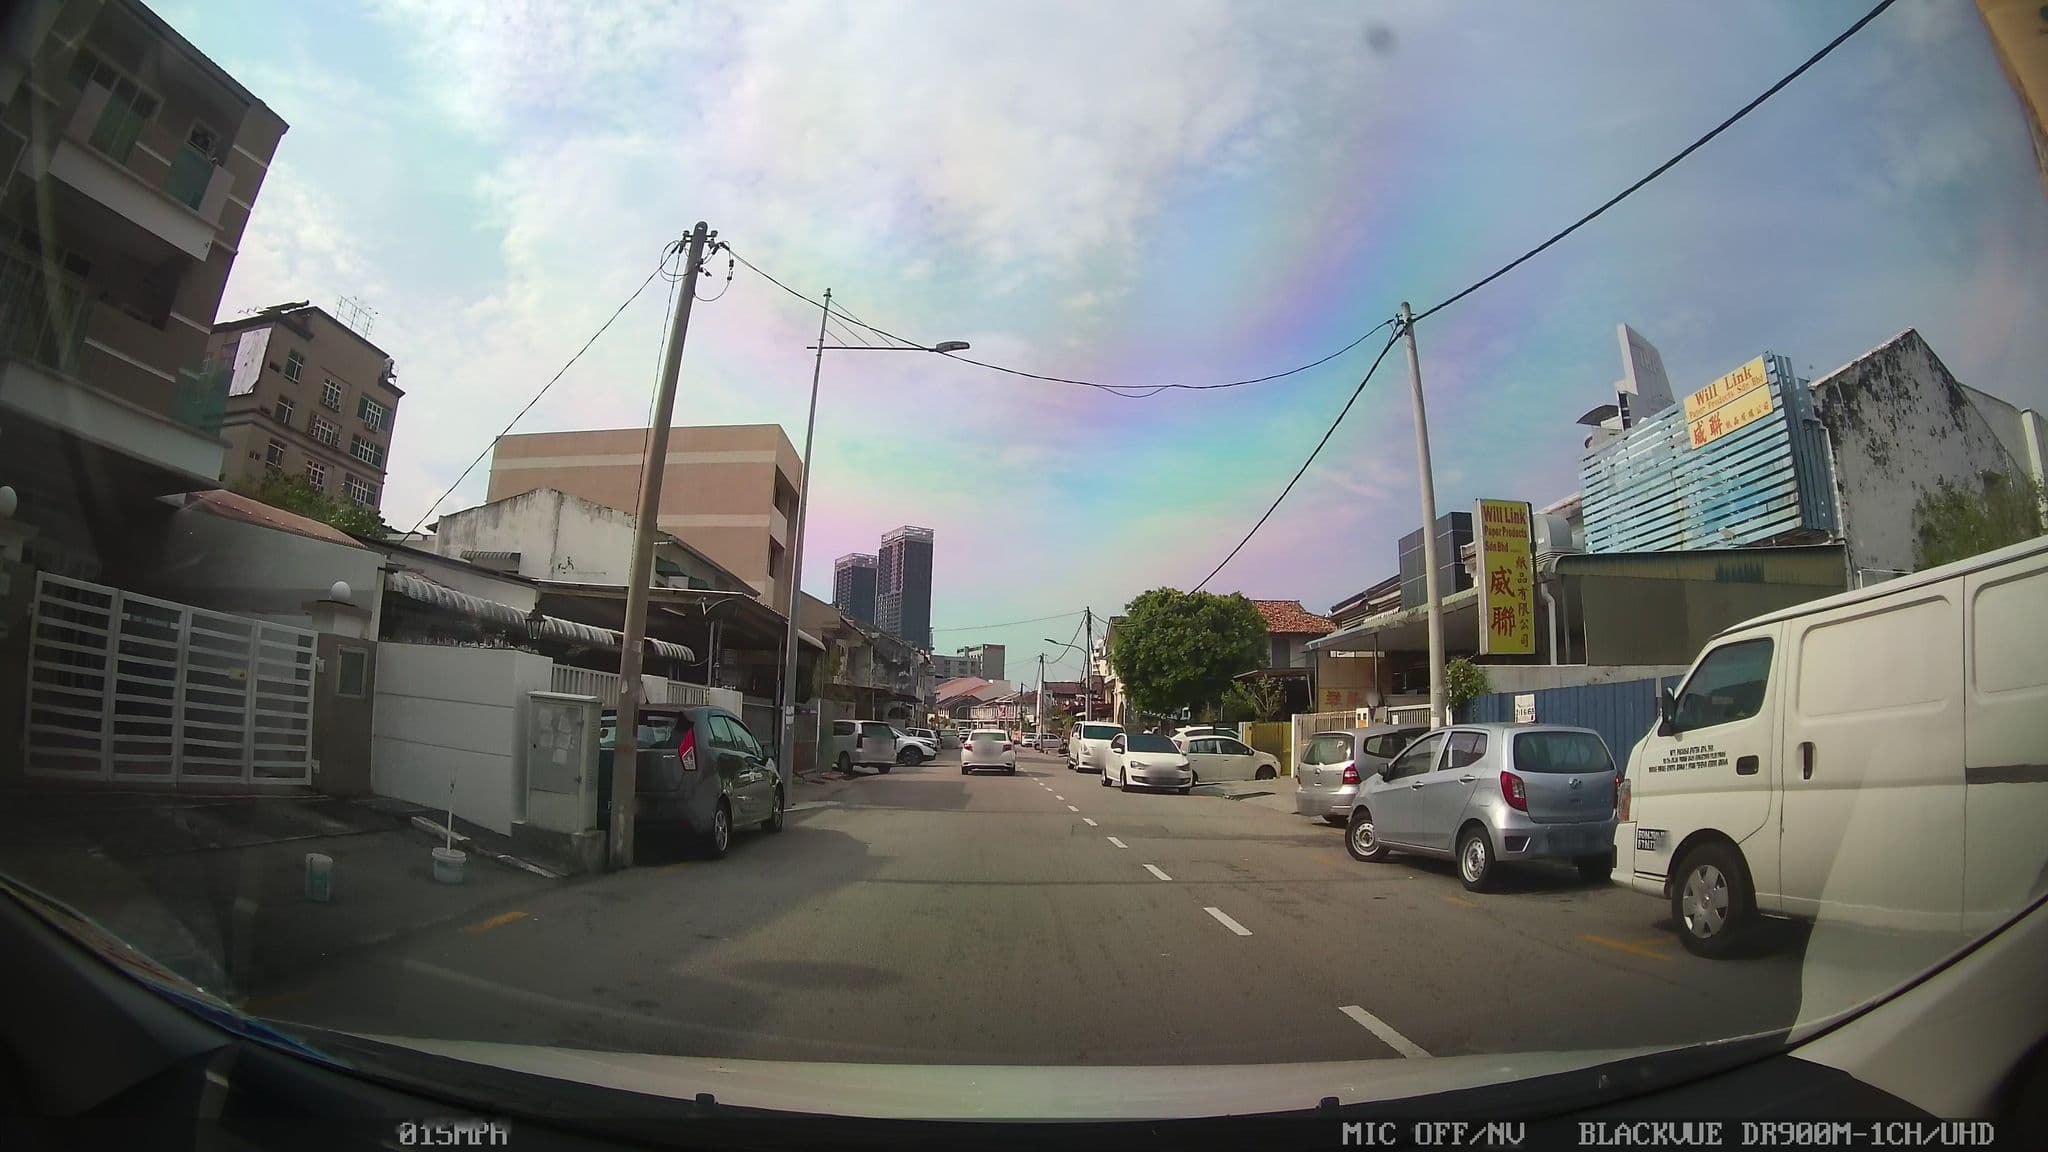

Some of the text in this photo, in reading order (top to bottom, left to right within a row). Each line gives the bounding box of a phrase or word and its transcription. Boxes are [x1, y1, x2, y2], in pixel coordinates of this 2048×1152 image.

[1695, 366, 1752, 406] Will Link
[1483, 505, 1526, 525] Will Link
[1484, 525, 1527, 539] Paper Products
[1484, 540, 1509, 553] Sdn Bhd
[1490, 566, 1517, 638] 威聯
